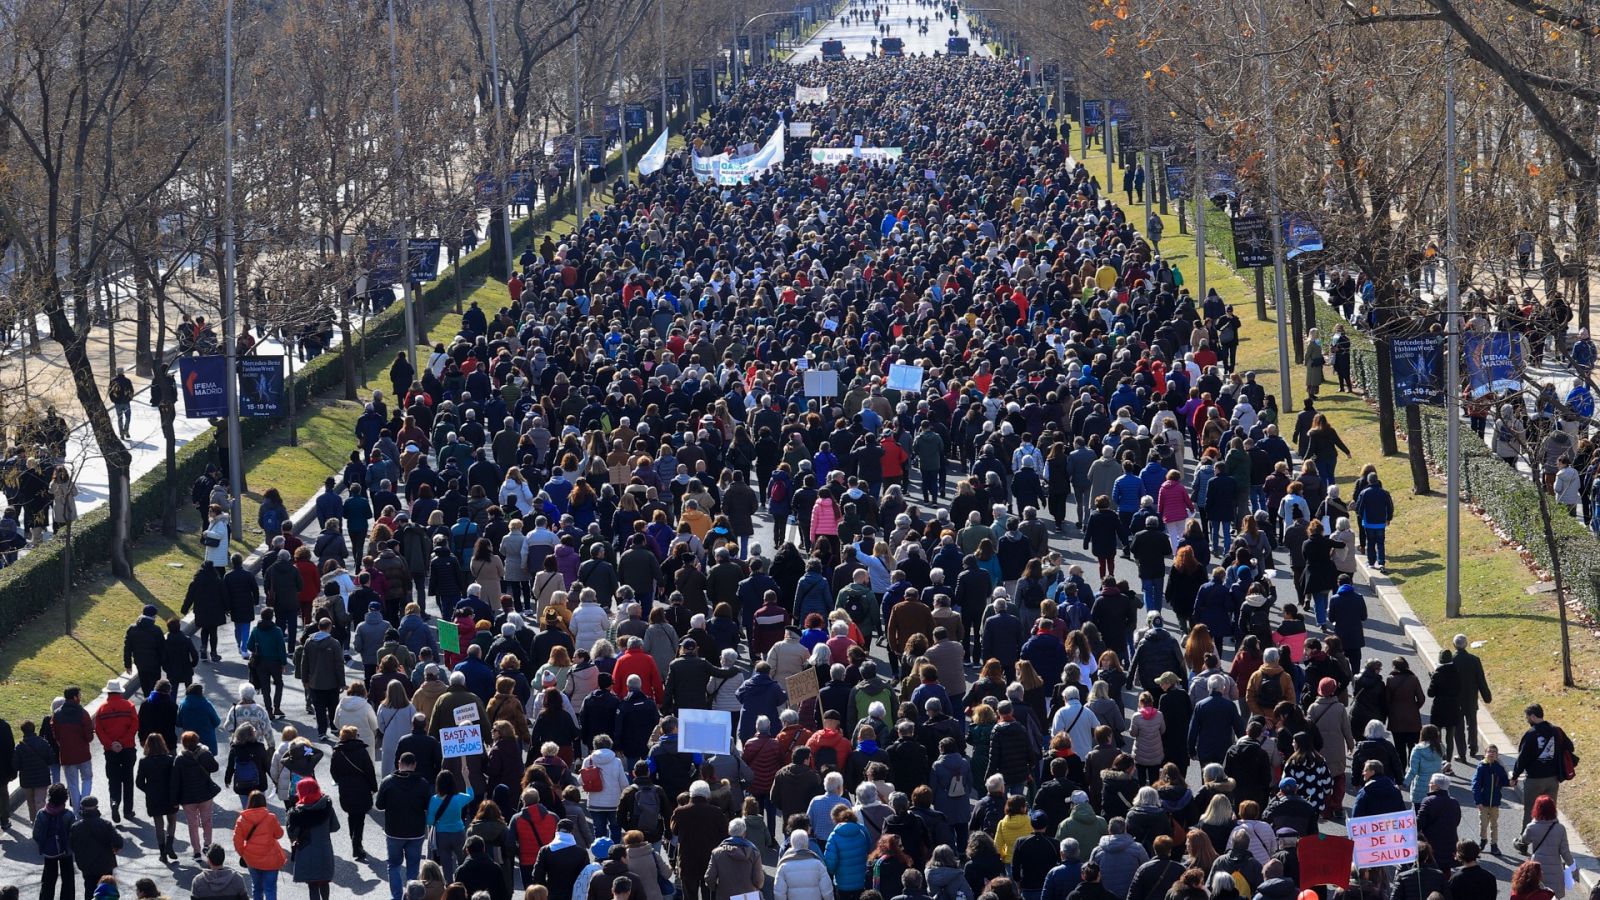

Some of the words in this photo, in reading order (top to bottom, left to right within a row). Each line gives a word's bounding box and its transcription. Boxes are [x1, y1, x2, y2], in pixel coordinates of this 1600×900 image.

[1393, 338, 1438, 346] Mercedes-Ben
[194, 382, 217, 390] IFEMA
[195, 387, 223, 396] MADRID
[443, 729, 468, 741] BASTA
[468, 727, 480, 737] YA
[443, 742, 482, 755] PAYUSADAS
[1352, 823, 1367, 836] EN
[1371, 835, 1386, 847] DE
[1394, 835, 1407, 843] LA
